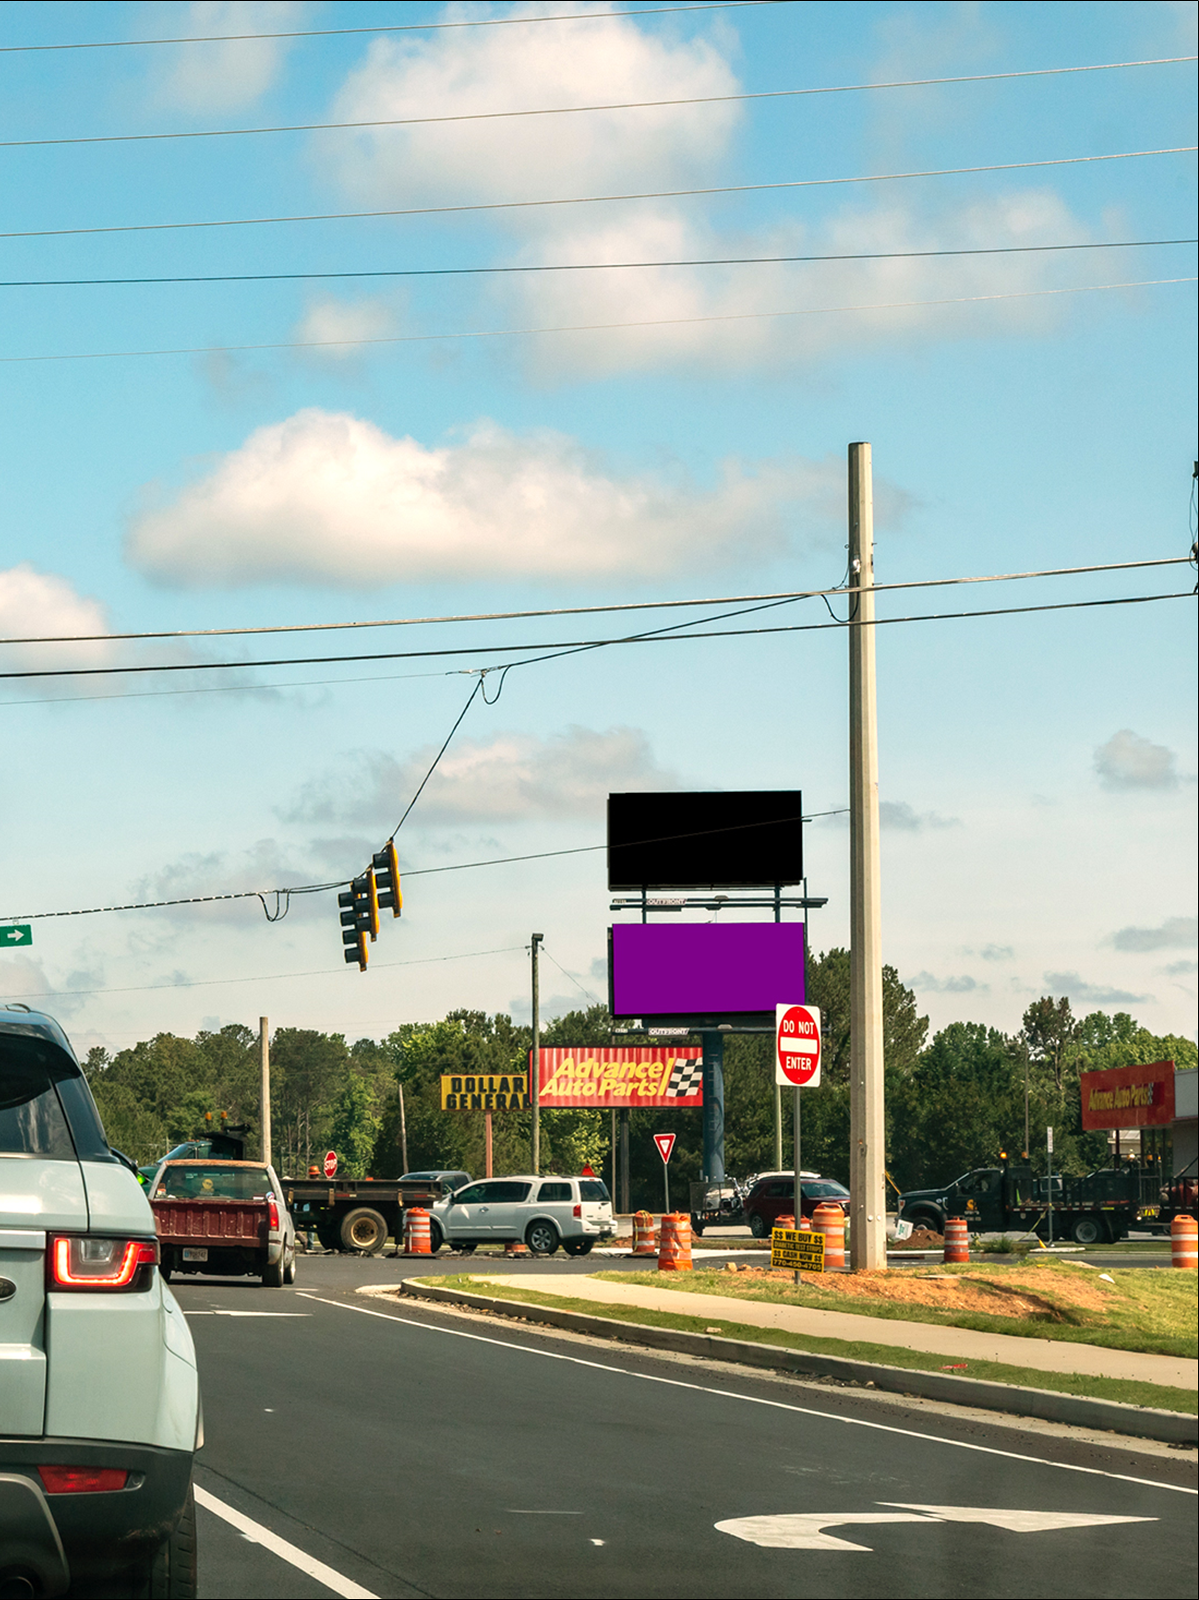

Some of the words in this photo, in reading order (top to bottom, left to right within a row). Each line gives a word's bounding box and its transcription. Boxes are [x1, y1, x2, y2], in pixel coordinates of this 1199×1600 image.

[783, 1020, 795, 1033] DO
[798, 1021, 815, 1035] NOT
[552, 1057, 665, 1079] Advance
[786, 1056, 812, 1070] ENTER
[451, 1077, 524, 1092] DOLLAR
[538, 1078, 597, 1097] Auto
[597, 1078, 659, 1097] Parts
[446, 1093, 532, 1110] GENERAL
[325, 1159, 337, 1170] STOP
[785, 1231, 796, 1241] WE
[798, 1233, 812, 1243] BUY
